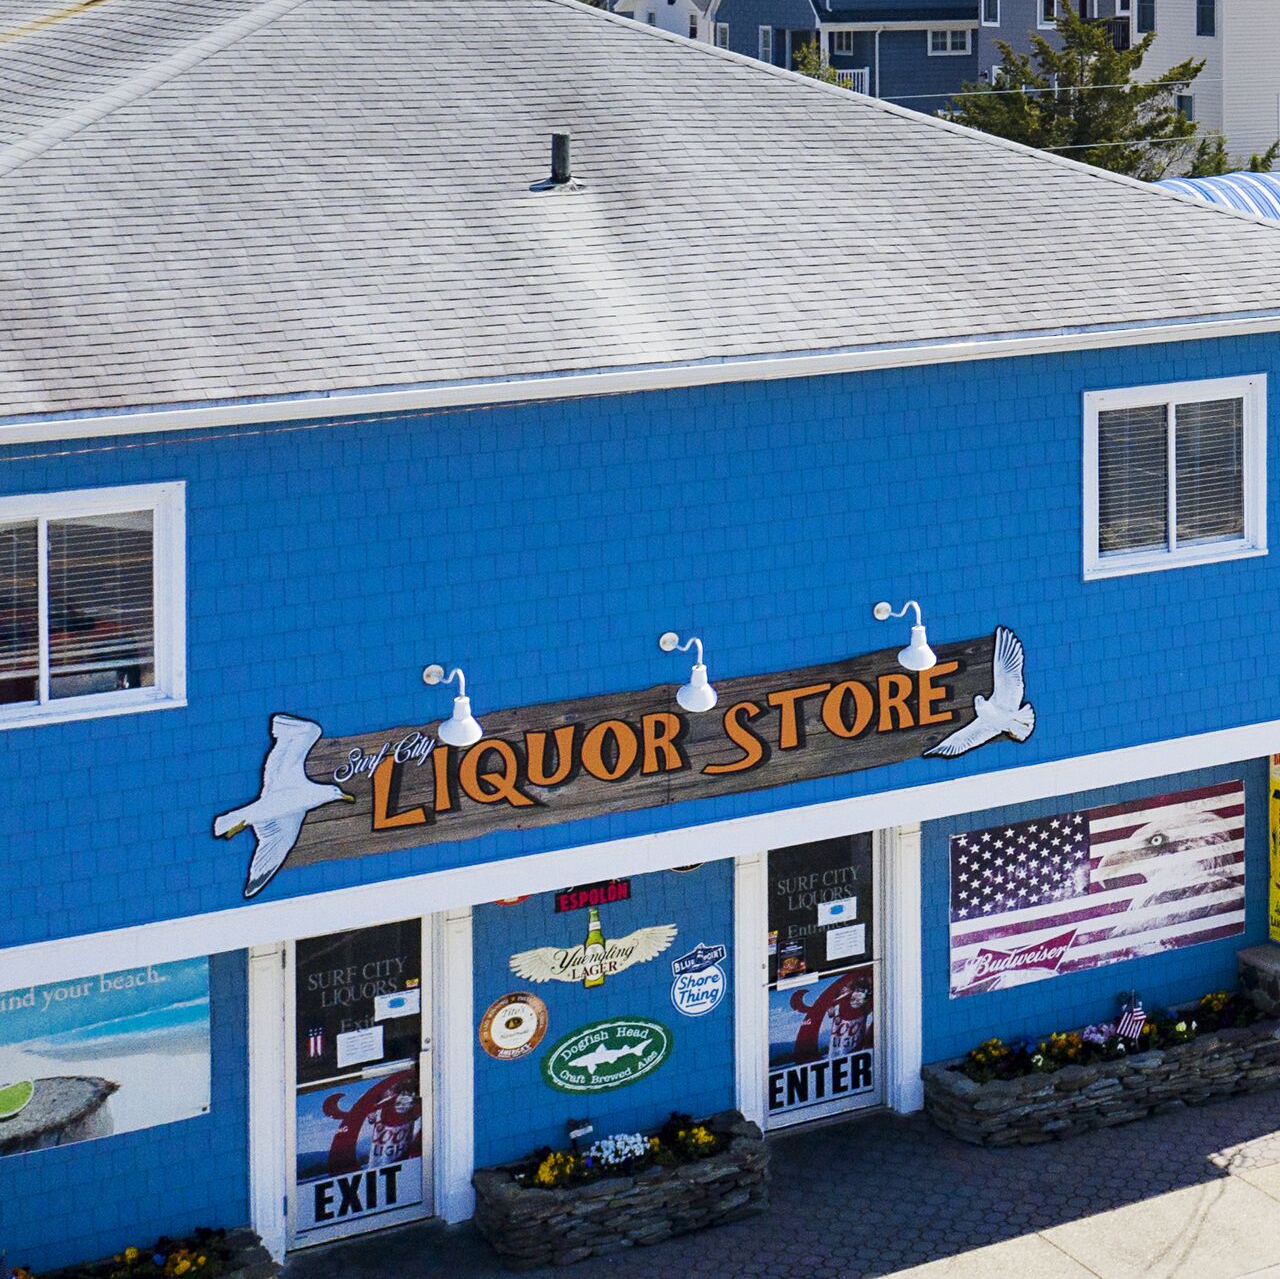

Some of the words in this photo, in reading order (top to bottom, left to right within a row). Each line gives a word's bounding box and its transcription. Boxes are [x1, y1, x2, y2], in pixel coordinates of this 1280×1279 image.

[333, 741, 391, 782] Surf
[393, 731, 435, 766] City
[372, 712, 684, 831] LIQUOR
[703, 660, 959, 776] STORE
[777, 873, 818, 896] SURF
[823, 865, 860, 886] CITY
[551, 938, 639, 975] Yuengling
[571, 960, 618, 980] LAGER
[674, 958, 695, 973] BLUE
[974, 944, 1071, 977] Budweiser
[307, 966, 358, 991] SURF
[363, 957, 408, 979] CITY
[678, 974, 721, 991] Shore
[42, 982, 94, 1012] your
[320, 977, 398, 1008] LIQUORS
[679, 987, 719, 1005] Thing
[560, 1031, 609, 1061] Dogfish
[616, 1027, 650, 1039] Head
[560, 1069, 586, 1083] Craft
[591, 1067, 632, 1084] Brewed
[637, 1050, 658, 1070] Ales
[769, 1052, 872, 1111] ENTER
[314, 1164, 402, 1223] EXIT
